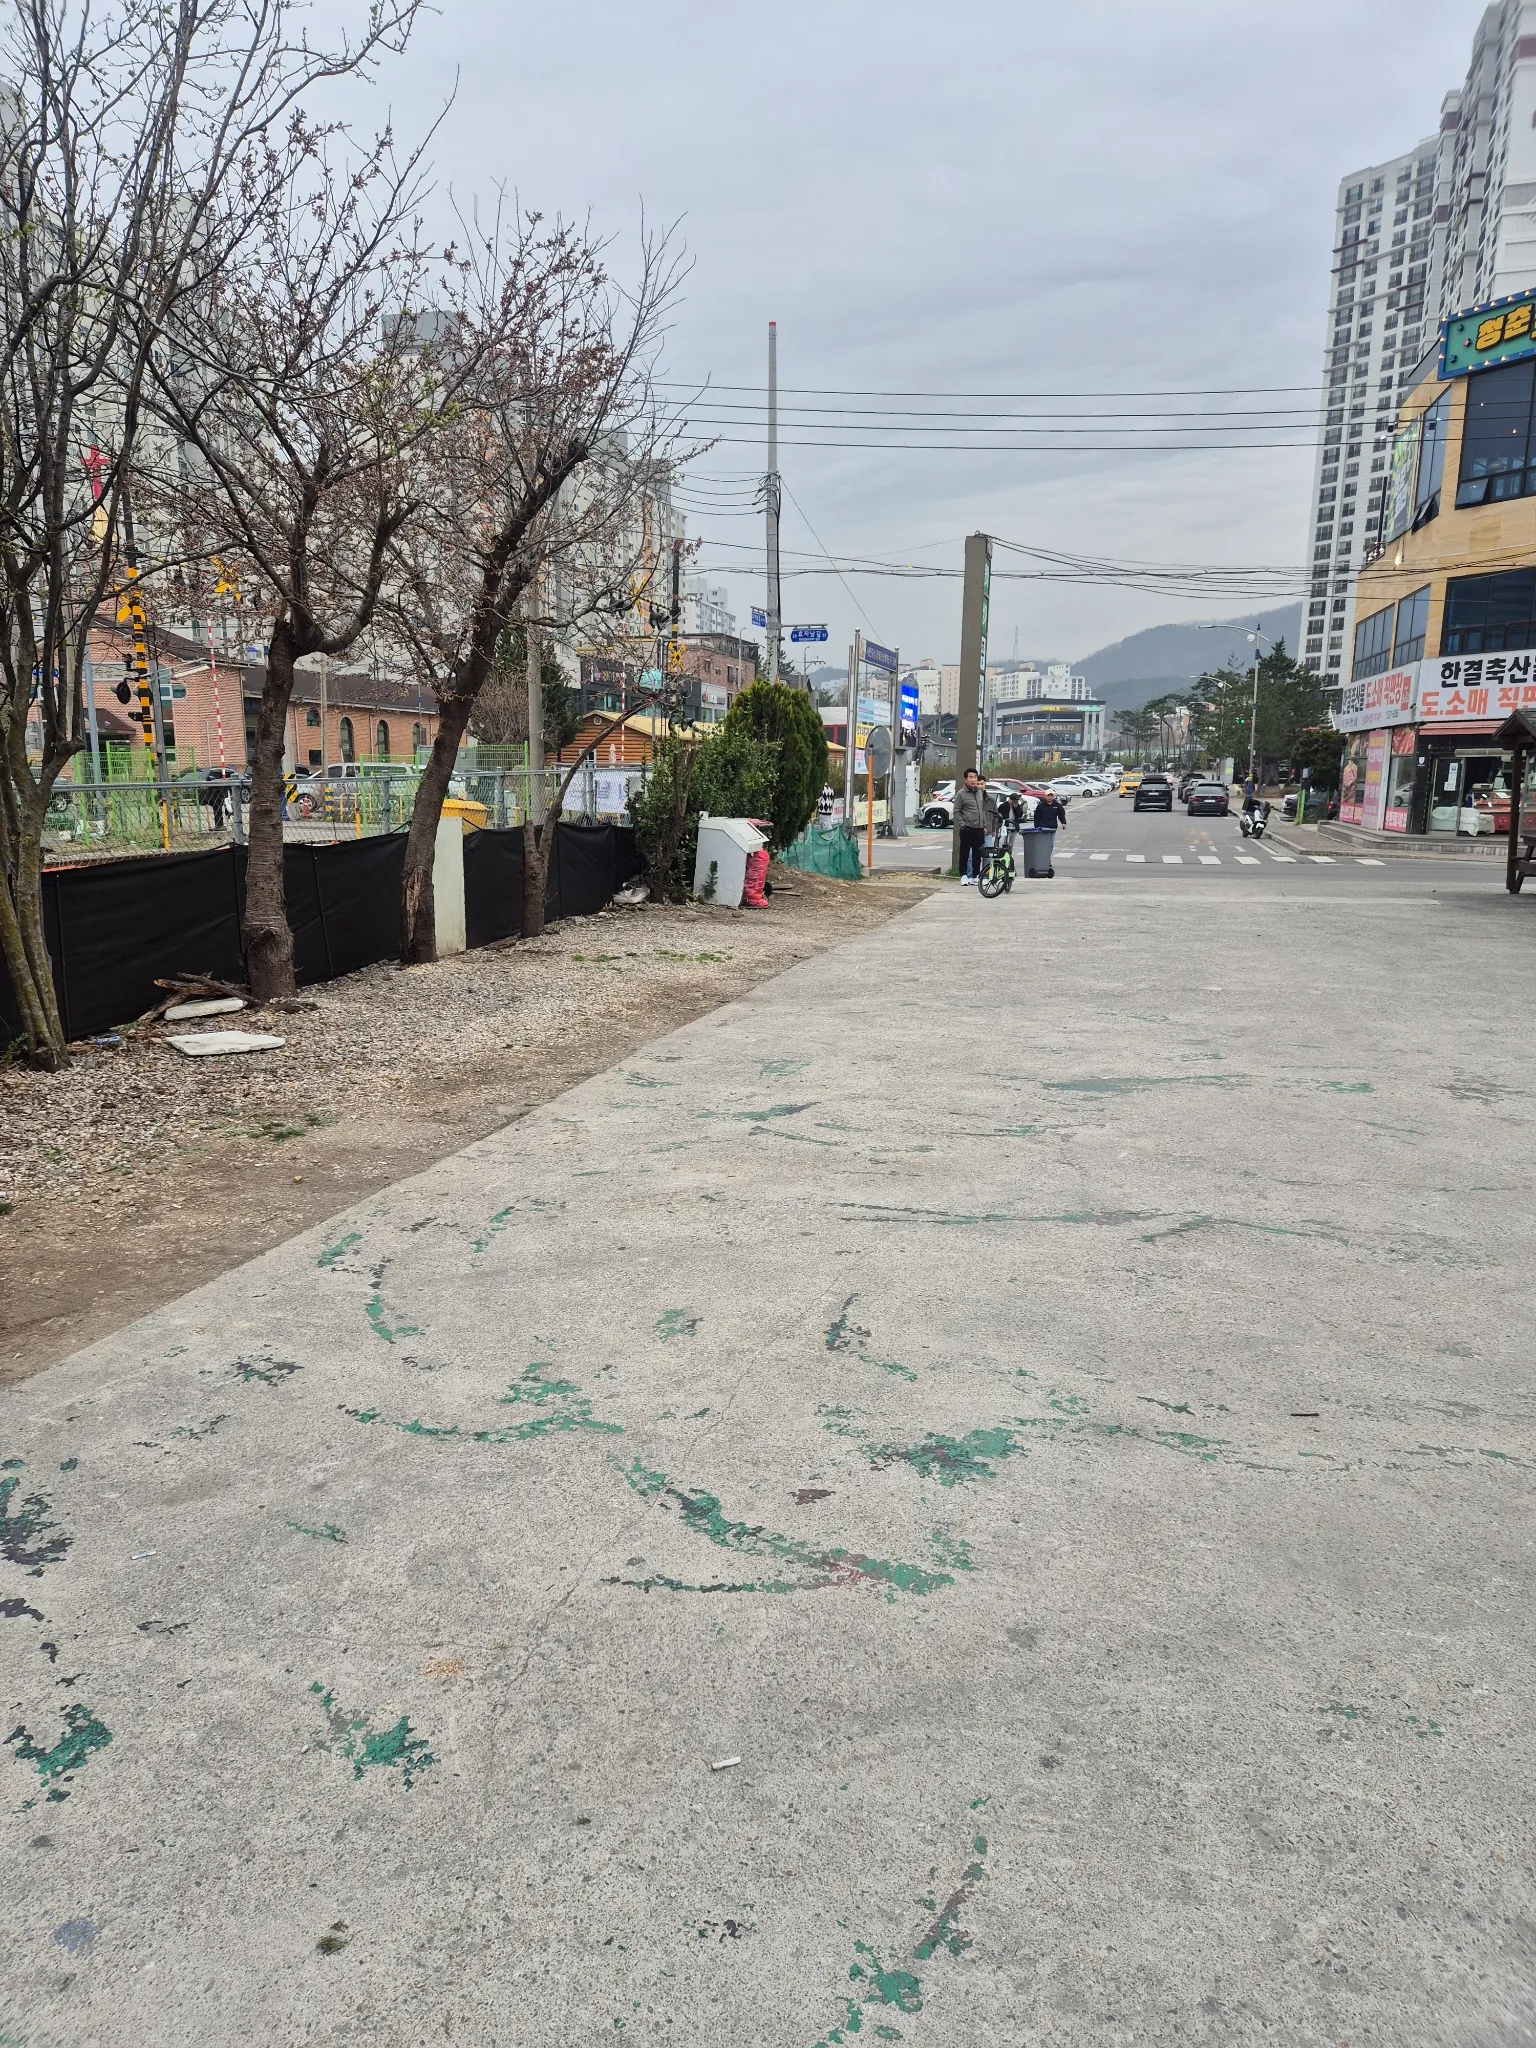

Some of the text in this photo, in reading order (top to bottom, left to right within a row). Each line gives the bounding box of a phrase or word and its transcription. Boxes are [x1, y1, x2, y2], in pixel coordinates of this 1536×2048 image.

[1475, 303, 1536, 351] 청춘
[798, 630, 822, 638] 효자남길
[1440, 655, 1536, 689] 한결축산
[1420, 688, 1489, 717] 도.소매
